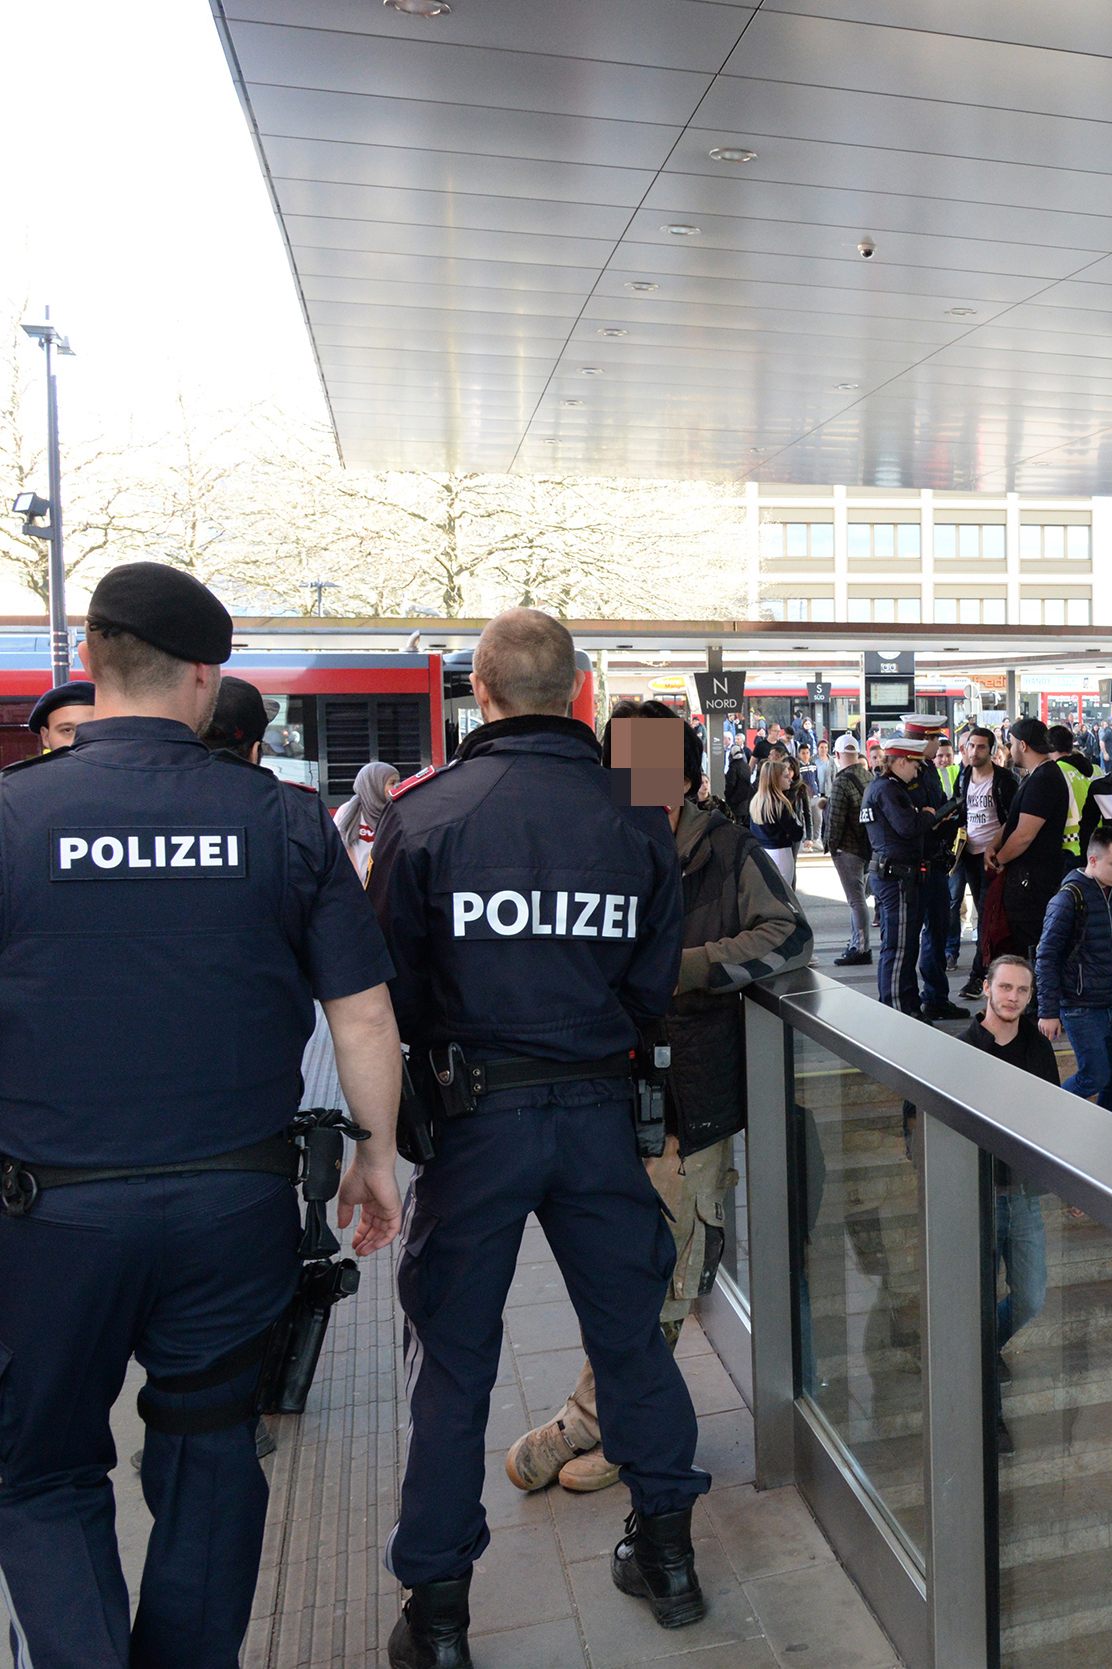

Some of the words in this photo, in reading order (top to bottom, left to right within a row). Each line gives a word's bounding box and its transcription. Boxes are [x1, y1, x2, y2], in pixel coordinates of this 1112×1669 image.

[713, 677, 728, 695] N
[816, 684, 822, 694] S
[706, 698, 738, 710] NORD
[813, 693, 825, 701] SÜD
[979, 794, 994, 808] FOR
[58, 835, 240, 870] POLIZEI
[453, 889, 639, 939] POLIZEI
